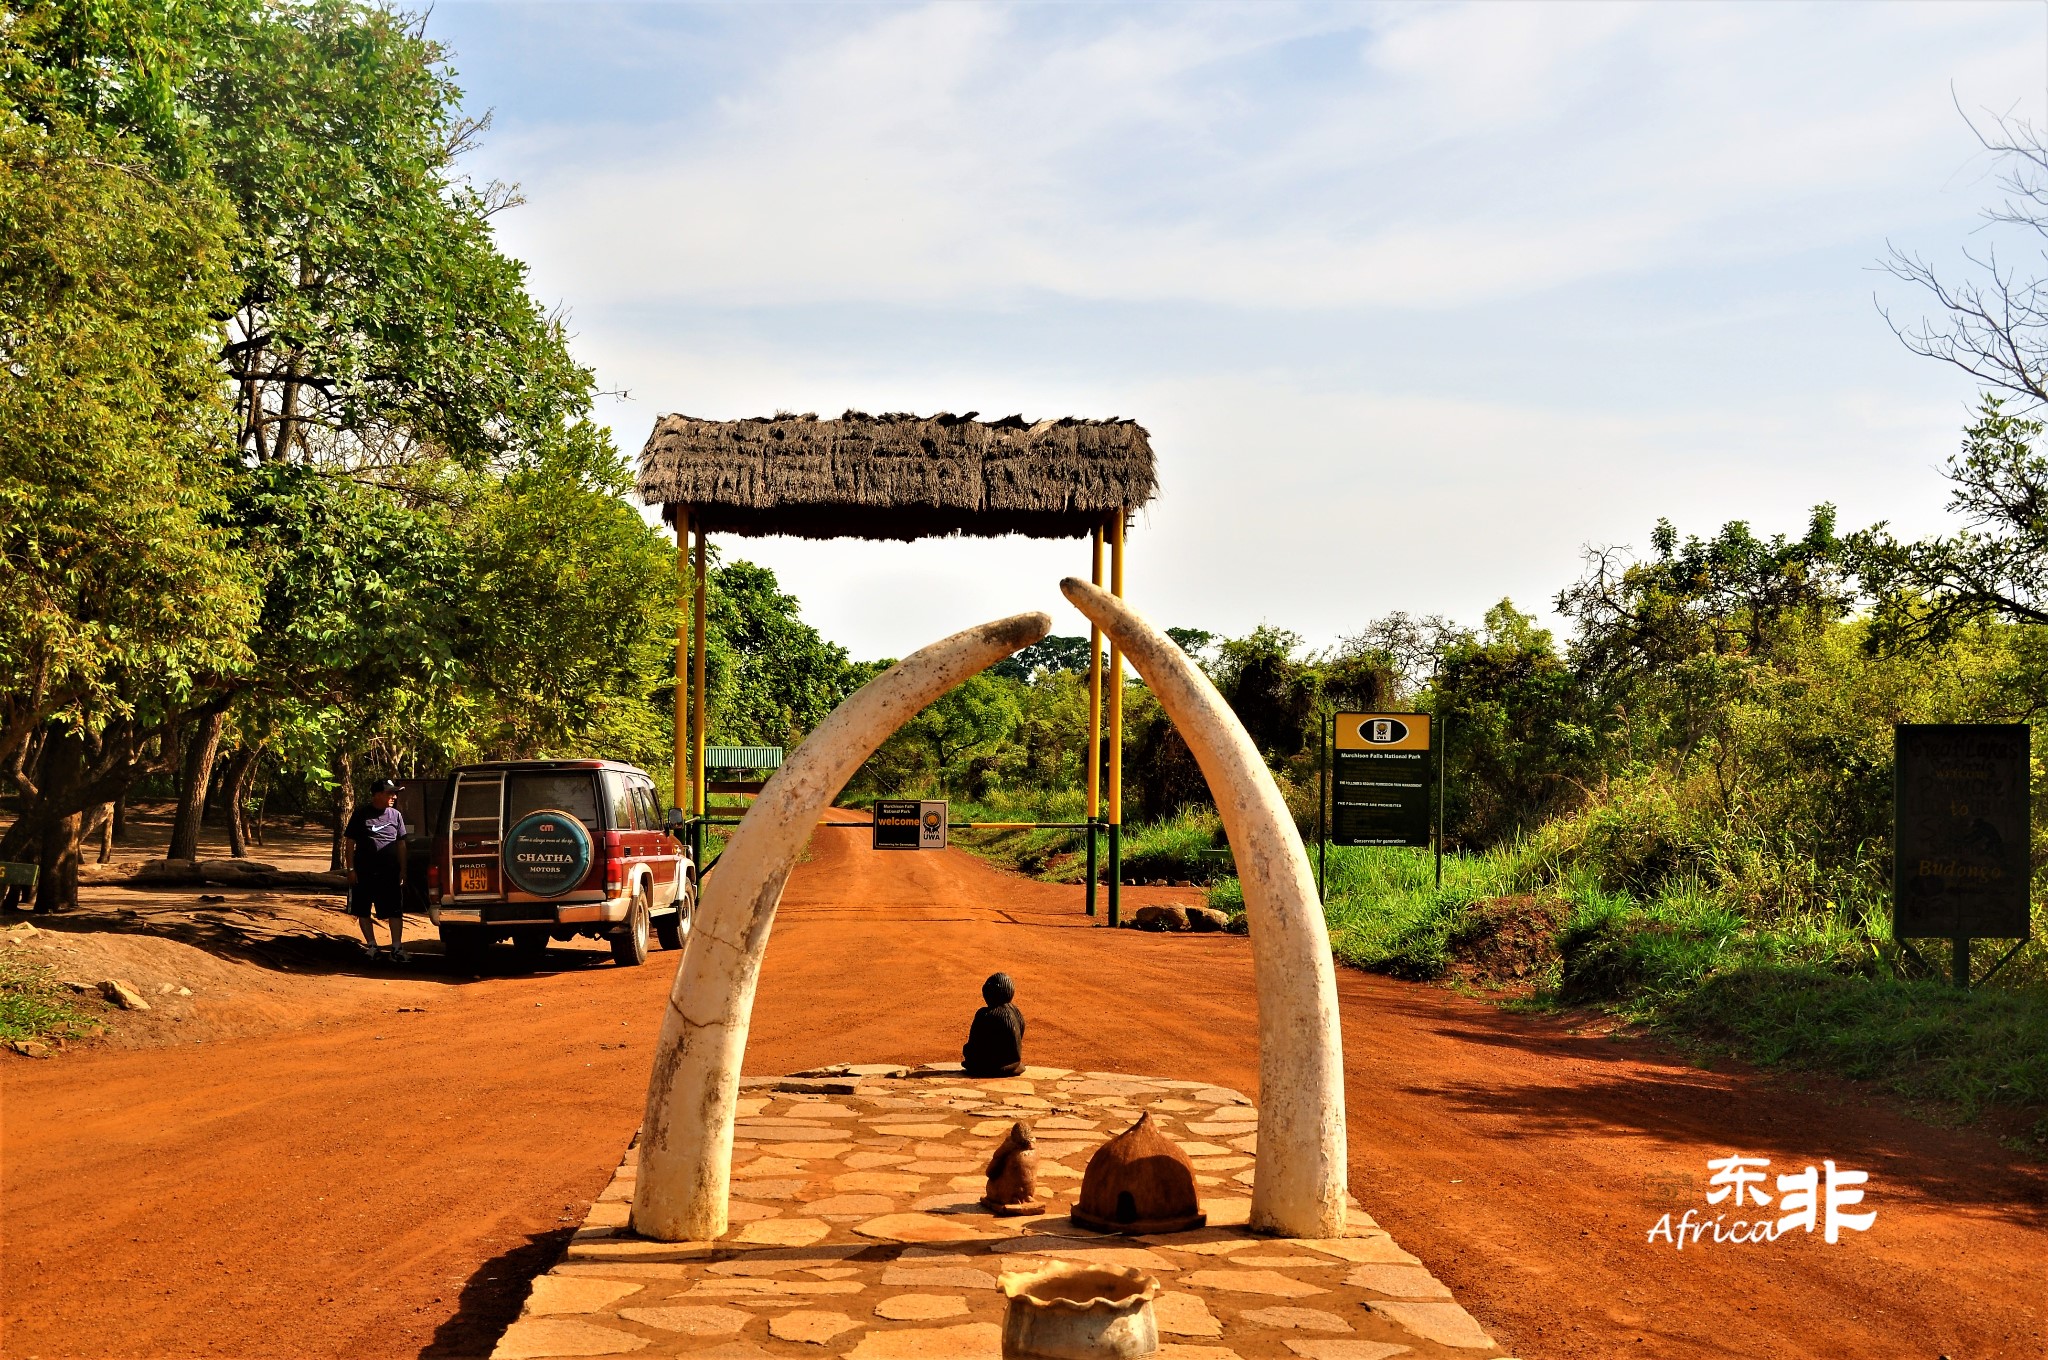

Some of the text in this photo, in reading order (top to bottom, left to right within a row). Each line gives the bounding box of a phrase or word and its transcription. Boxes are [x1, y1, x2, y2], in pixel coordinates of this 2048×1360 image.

[878, 816, 920, 826] welcome
[516, 853, 574, 863] CHATHA
[468, 869, 487, 879] UAN
[1919, 860, 2002, 884] Budongo
[464, 879, 487, 890] 453V
